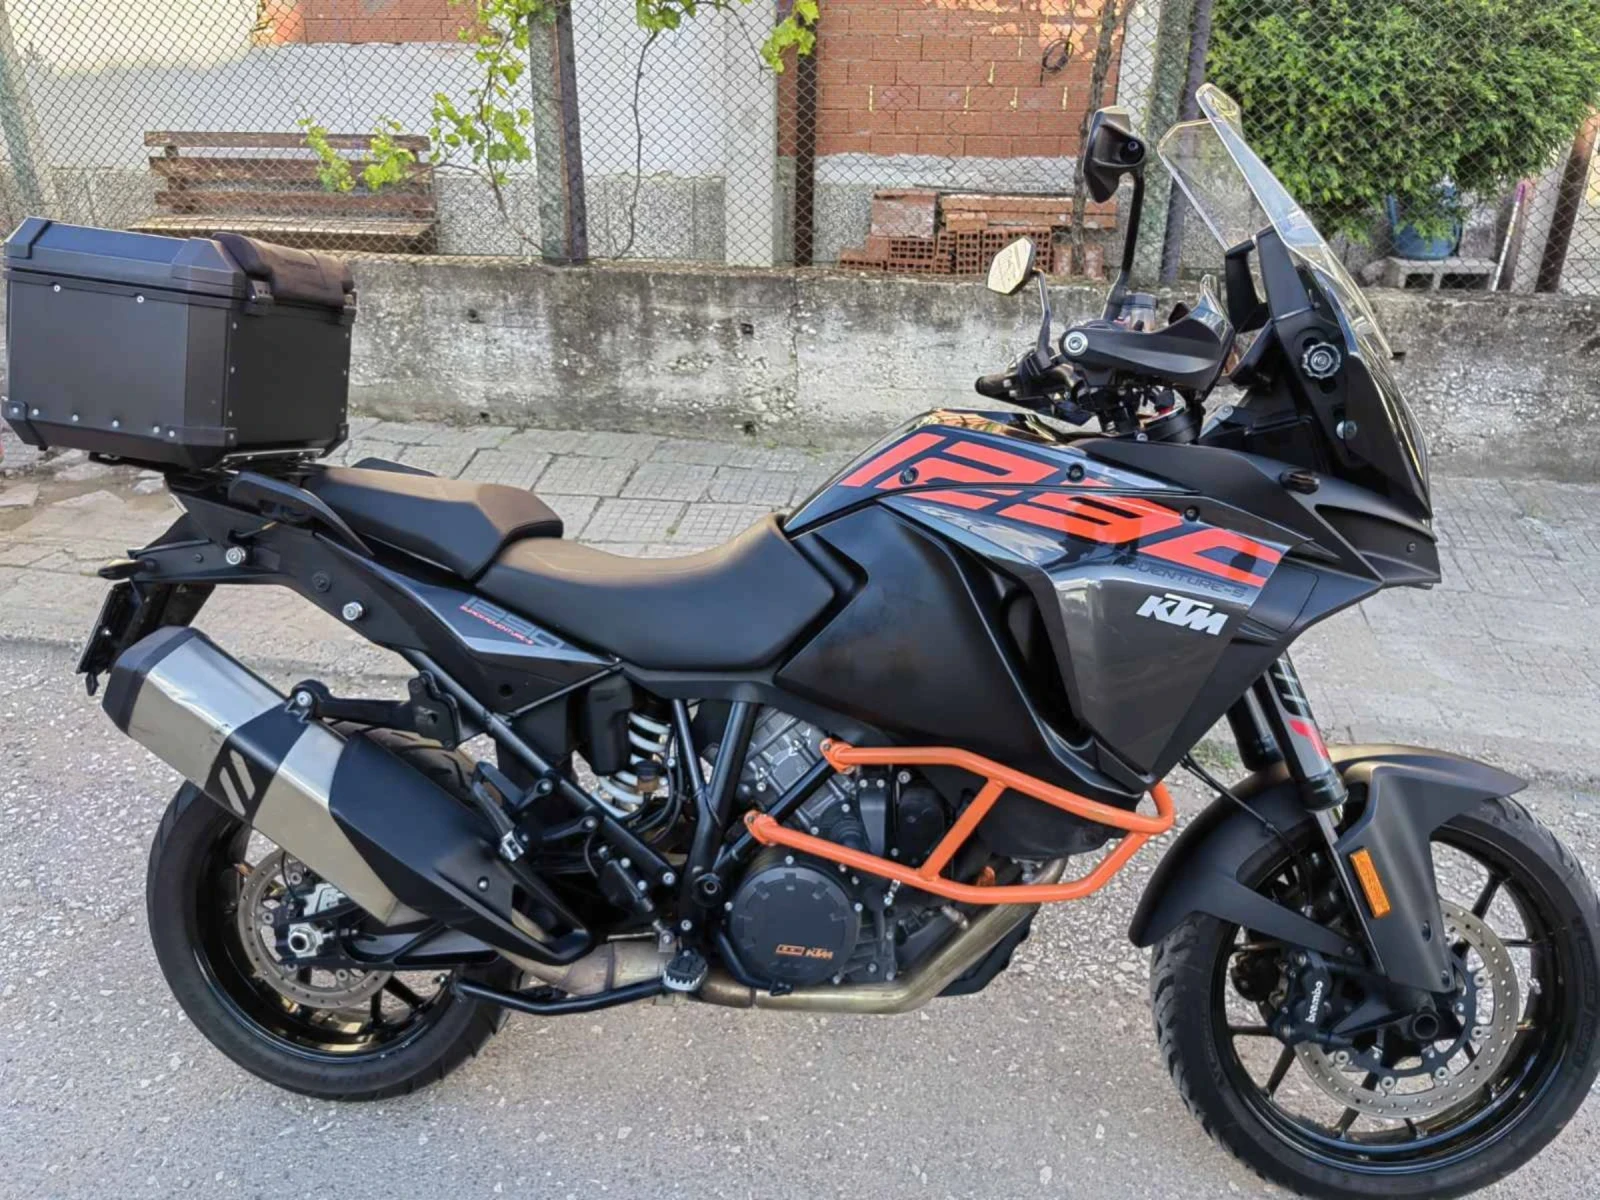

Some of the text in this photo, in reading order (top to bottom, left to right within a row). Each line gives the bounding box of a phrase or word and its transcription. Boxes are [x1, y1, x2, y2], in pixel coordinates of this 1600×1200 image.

[838, 432, 1283, 587] 1290
[1136, 593, 1229, 635] KTM
[806, 947, 834, 960] KTM
[1305, 980, 1323, 1023] brembo
